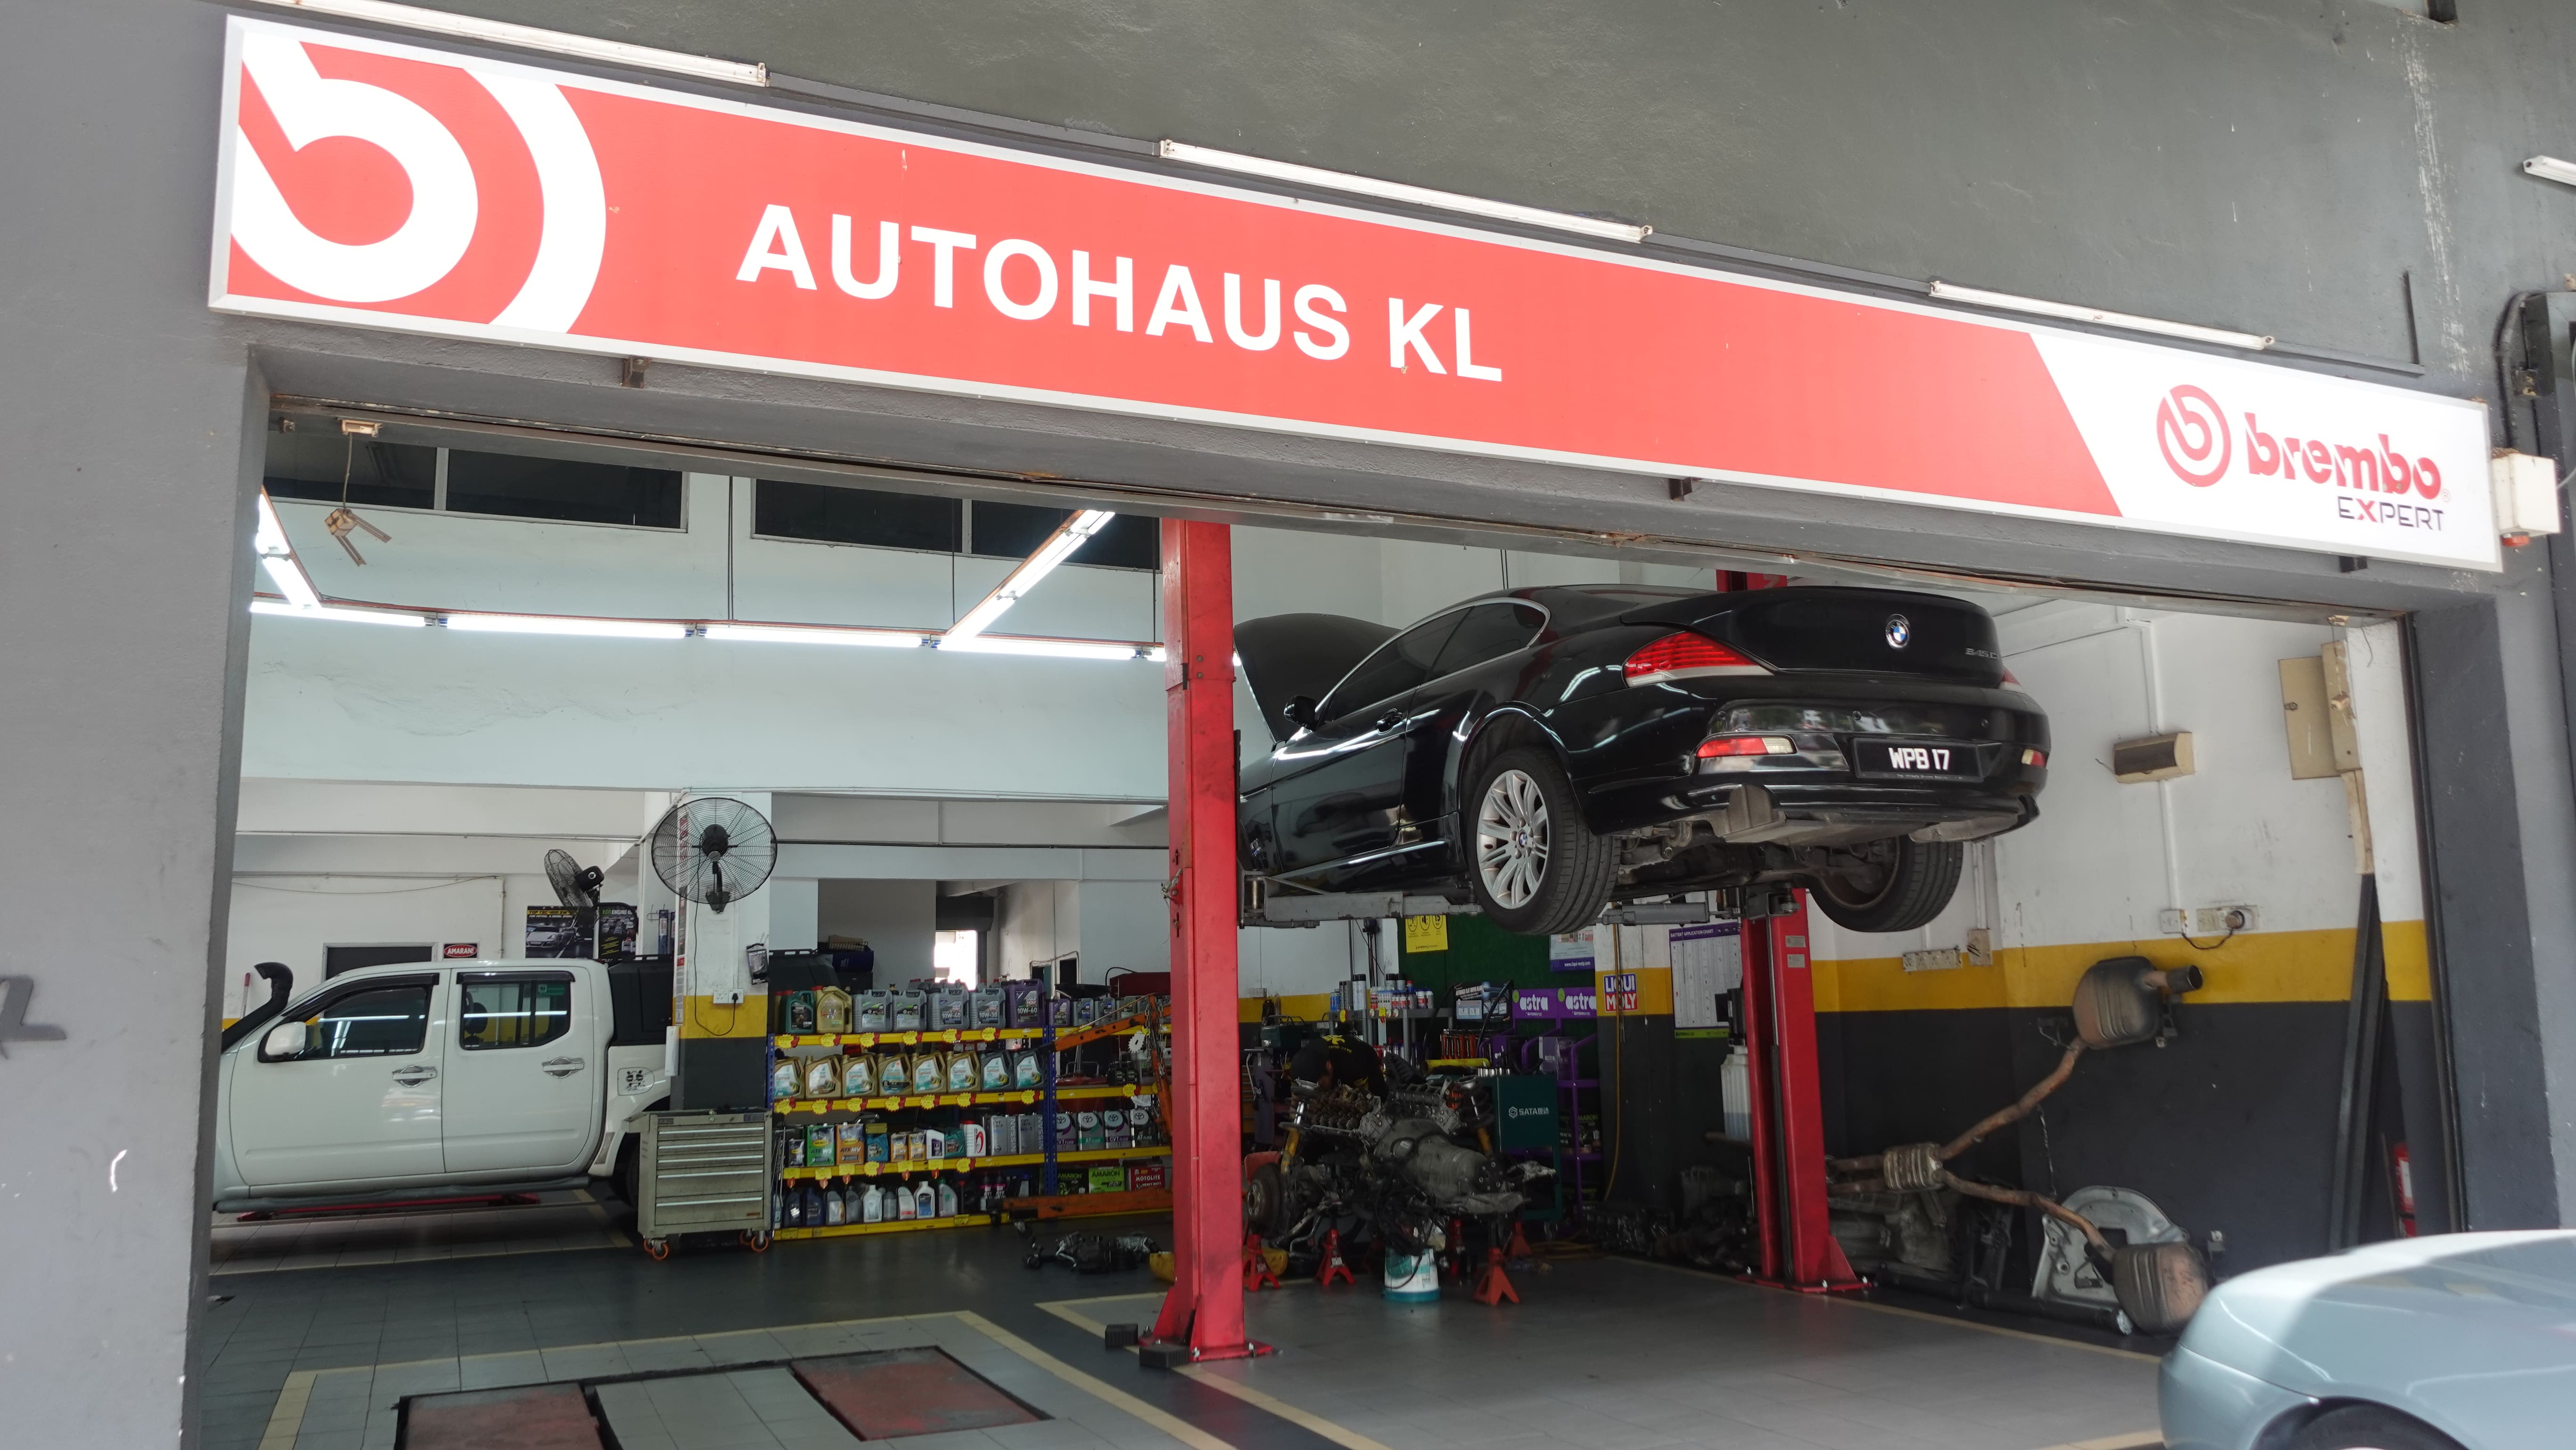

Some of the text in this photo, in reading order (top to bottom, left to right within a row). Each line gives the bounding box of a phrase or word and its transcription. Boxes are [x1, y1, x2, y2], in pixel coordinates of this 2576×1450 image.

[736, 203, 1502, 383] AUTOHAUS KL
[2244, 411, 2442, 500] brembo
[2337, 496, 2445, 531] EXPERT
[1888, 747, 1950, 771] WPB 17
[1520, 994, 1548, 1011] astra
[1565, 992, 1596, 1010] astra
